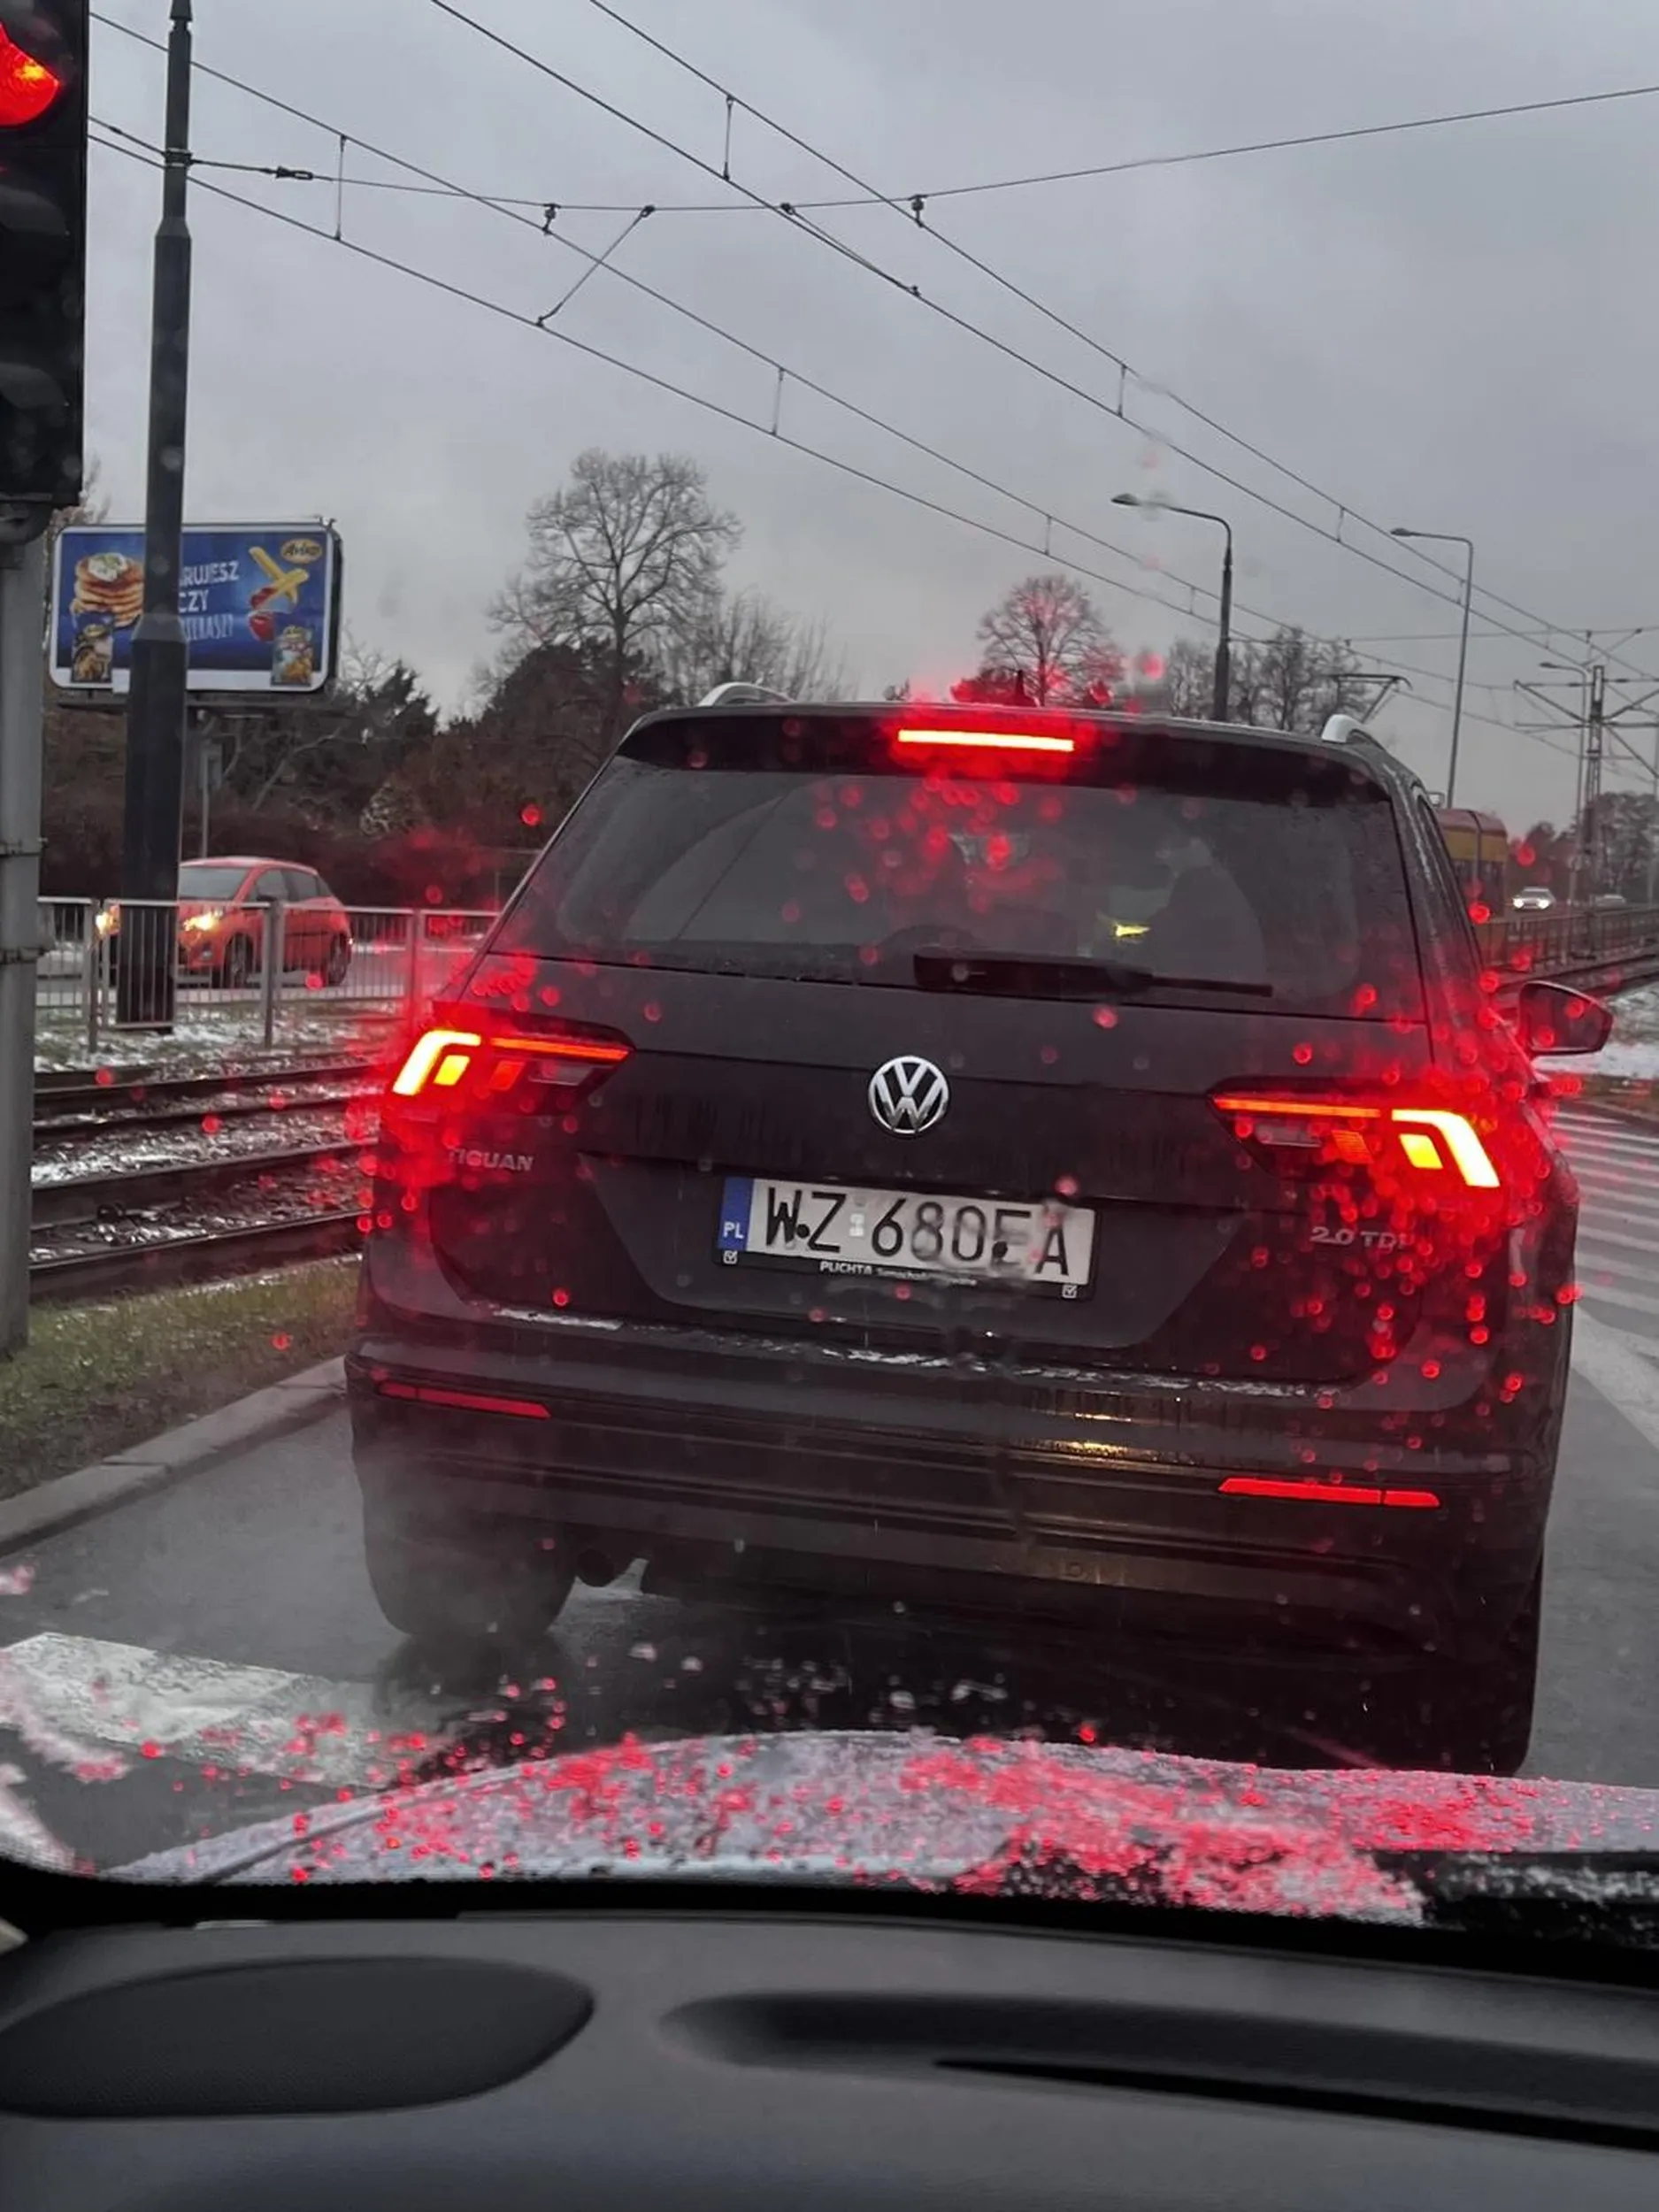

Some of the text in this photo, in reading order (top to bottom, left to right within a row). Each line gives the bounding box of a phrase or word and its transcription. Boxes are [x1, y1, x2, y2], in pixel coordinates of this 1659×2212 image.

[723, 1221, 744, 1239] PL
[765, 1187, 1070, 1277] WZ 680EA
